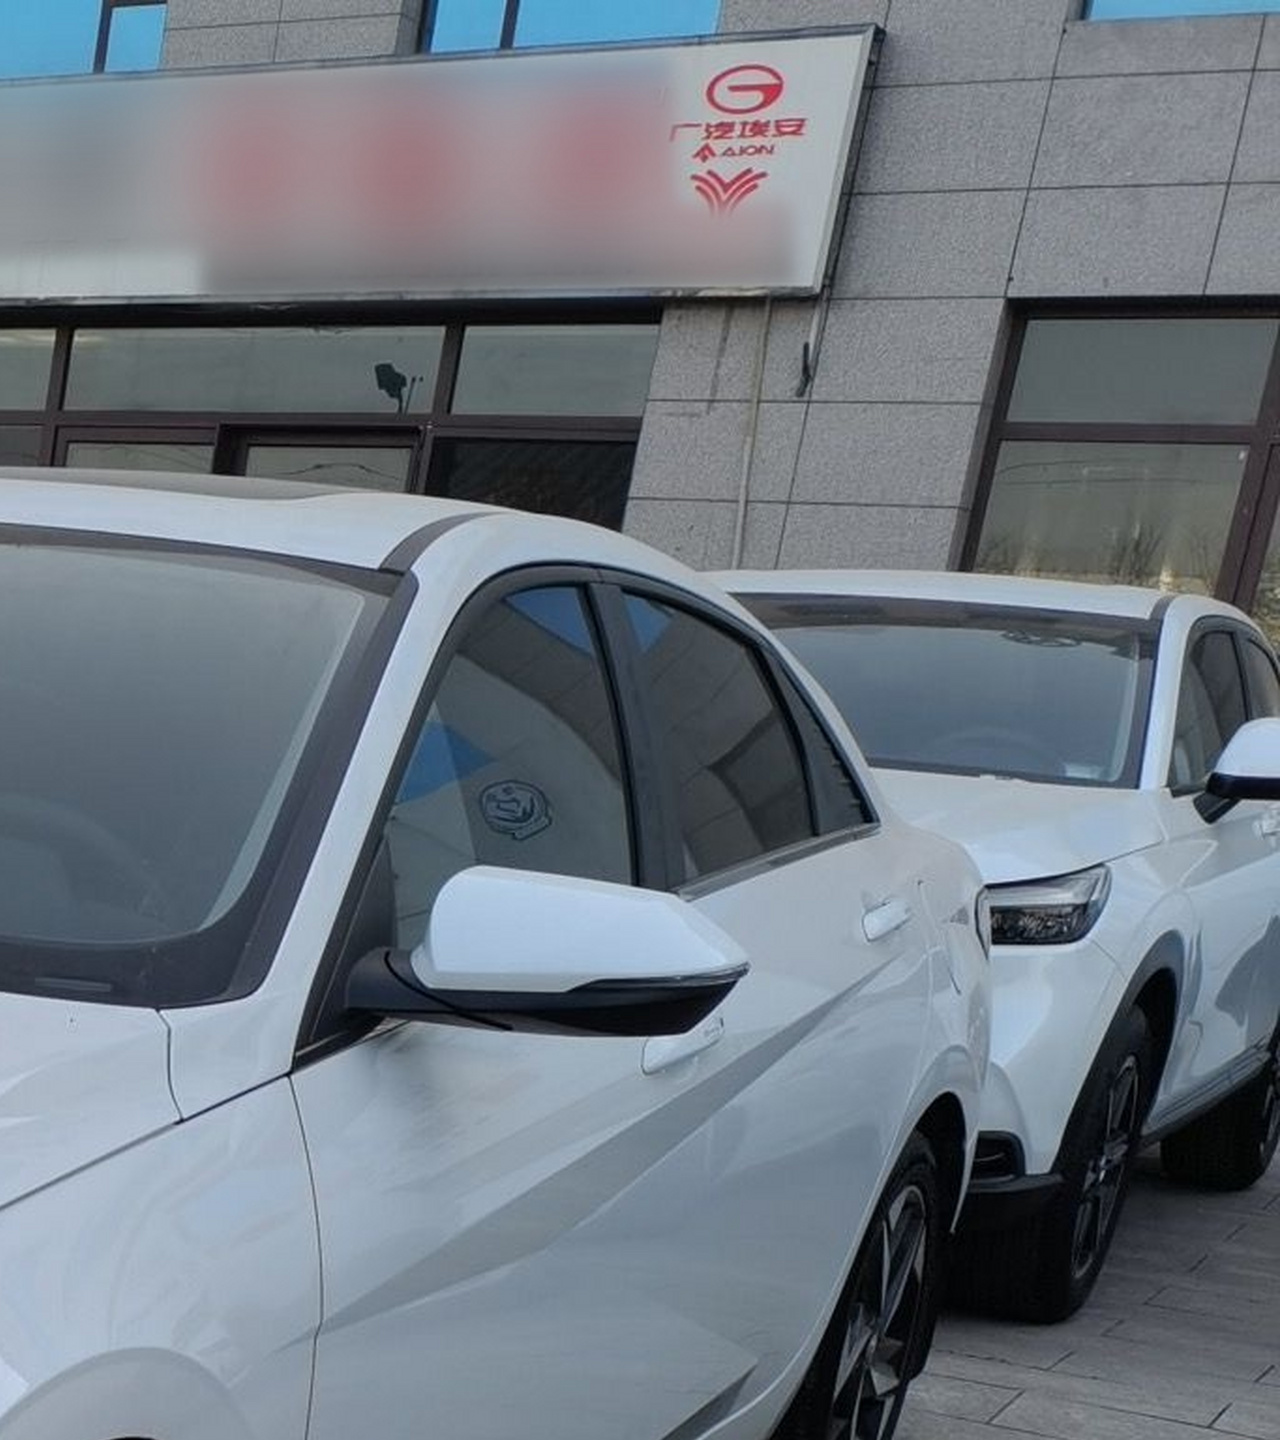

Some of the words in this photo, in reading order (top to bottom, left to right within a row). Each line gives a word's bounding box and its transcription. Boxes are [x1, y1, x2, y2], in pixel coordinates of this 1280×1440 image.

[669, 117, 808, 142] 广汽埃安
[721, 143, 775, 157] AION
